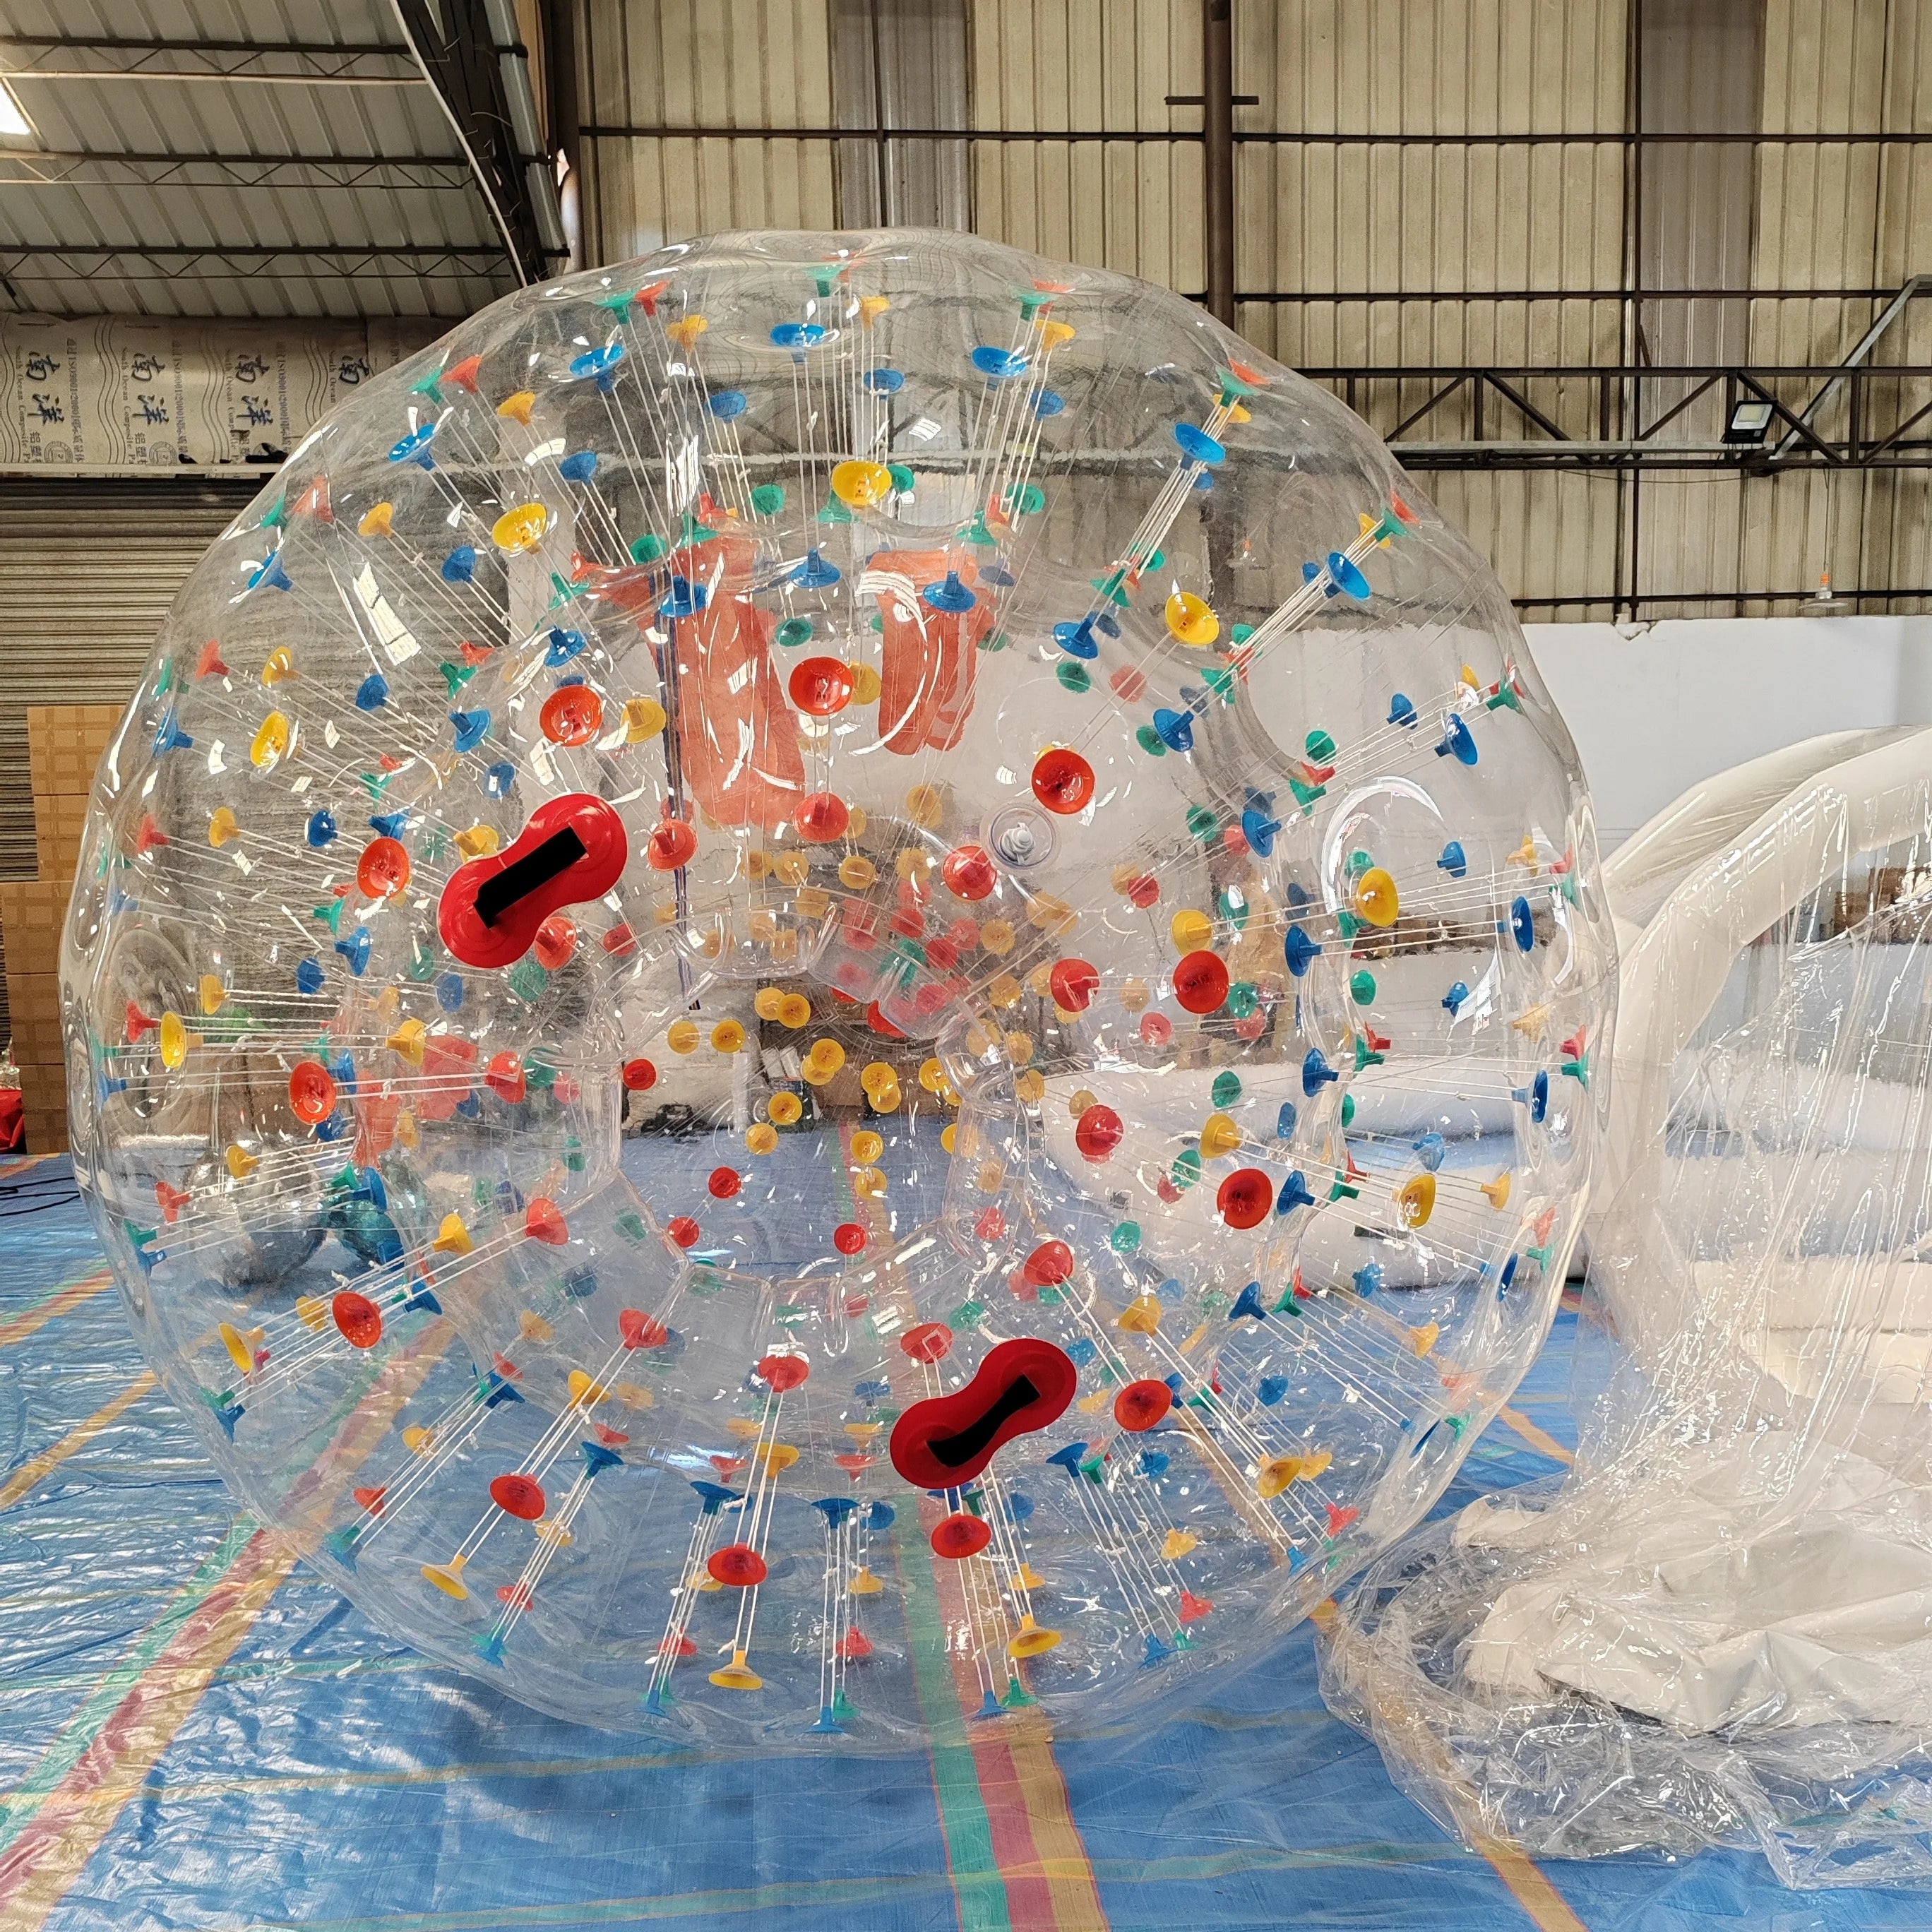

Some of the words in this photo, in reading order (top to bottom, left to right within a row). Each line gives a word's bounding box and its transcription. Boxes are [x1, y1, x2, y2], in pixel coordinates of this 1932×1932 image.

[26, 351, 64, 426] 南洋
[131, 352, 170, 427] 南洋
[235, 353, 273, 427] 南洋
[19, 405, 28, 448] Composite
[124, 406, 133, 448] Composite
